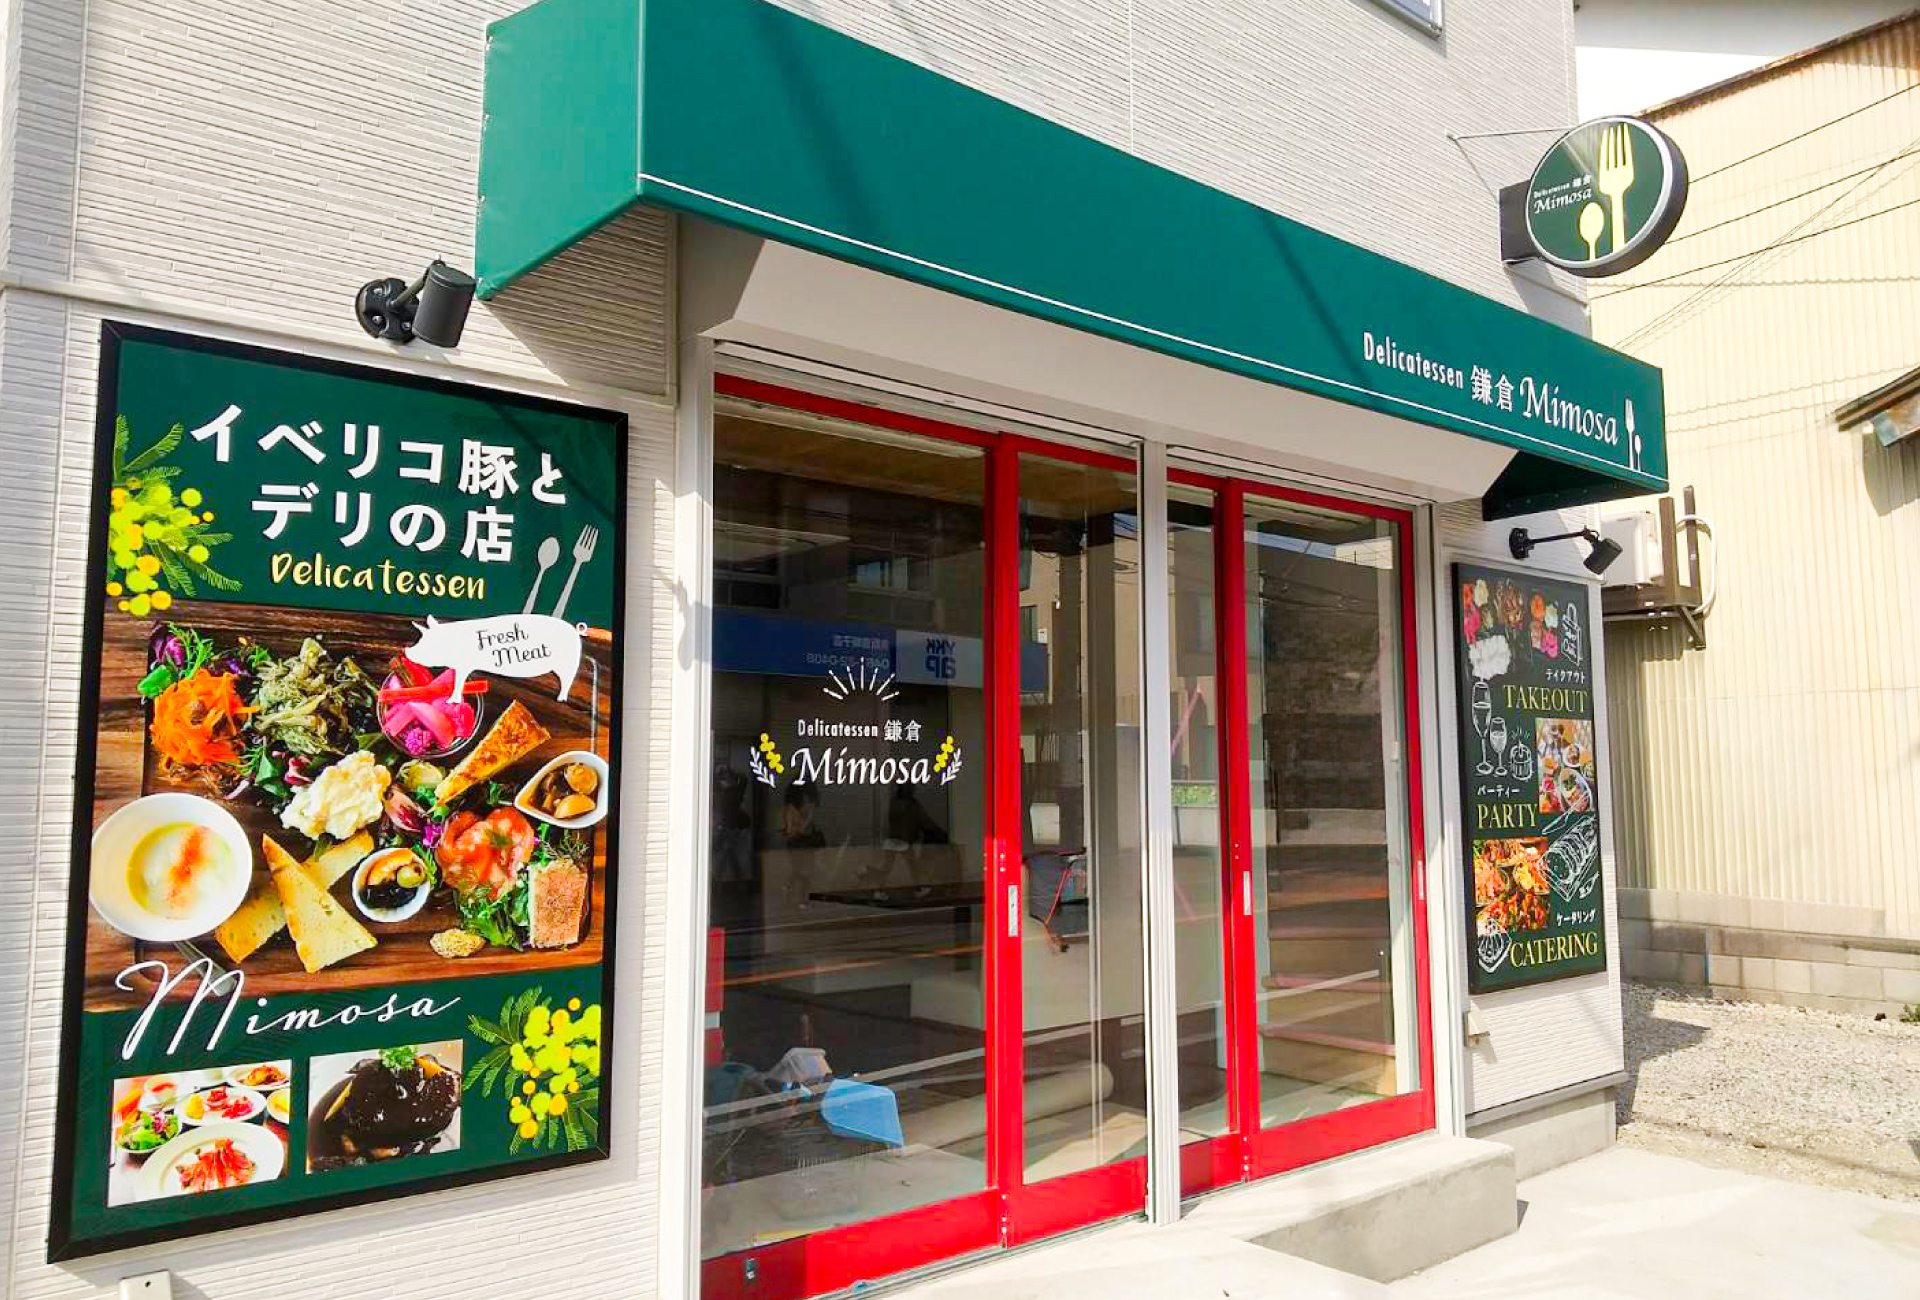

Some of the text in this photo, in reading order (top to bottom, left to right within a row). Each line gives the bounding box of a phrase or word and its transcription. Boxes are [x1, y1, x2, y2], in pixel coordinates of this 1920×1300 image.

[1534, 189, 1591, 214] Mimosa
[1363, 331, 1619, 446] Delicatessen 鎌倉 Mimosa
[190, 404, 567, 505] イベリコ豚と
[251, 482, 515, 563] デリの店
[270, 553, 485, 599] Delicatessen
[476, 622, 528, 651] Fresh
[492, 643, 552, 667] Meat
[1546, 669, 1586, 684] テイクアウト
[1503, 685, 1588, 713] TAKEOUT
[798, 718, 922, 742] Delicatessen 鎌倉
[790, 747, 930, 785] Mimosa
[1477, 784, 1520, 799] パーティー
[1476, 802, 1540, 830] PARTY
[1510, 932, 1598, 968] CATERING
[115, 958, 462, 1061] Mimosa
